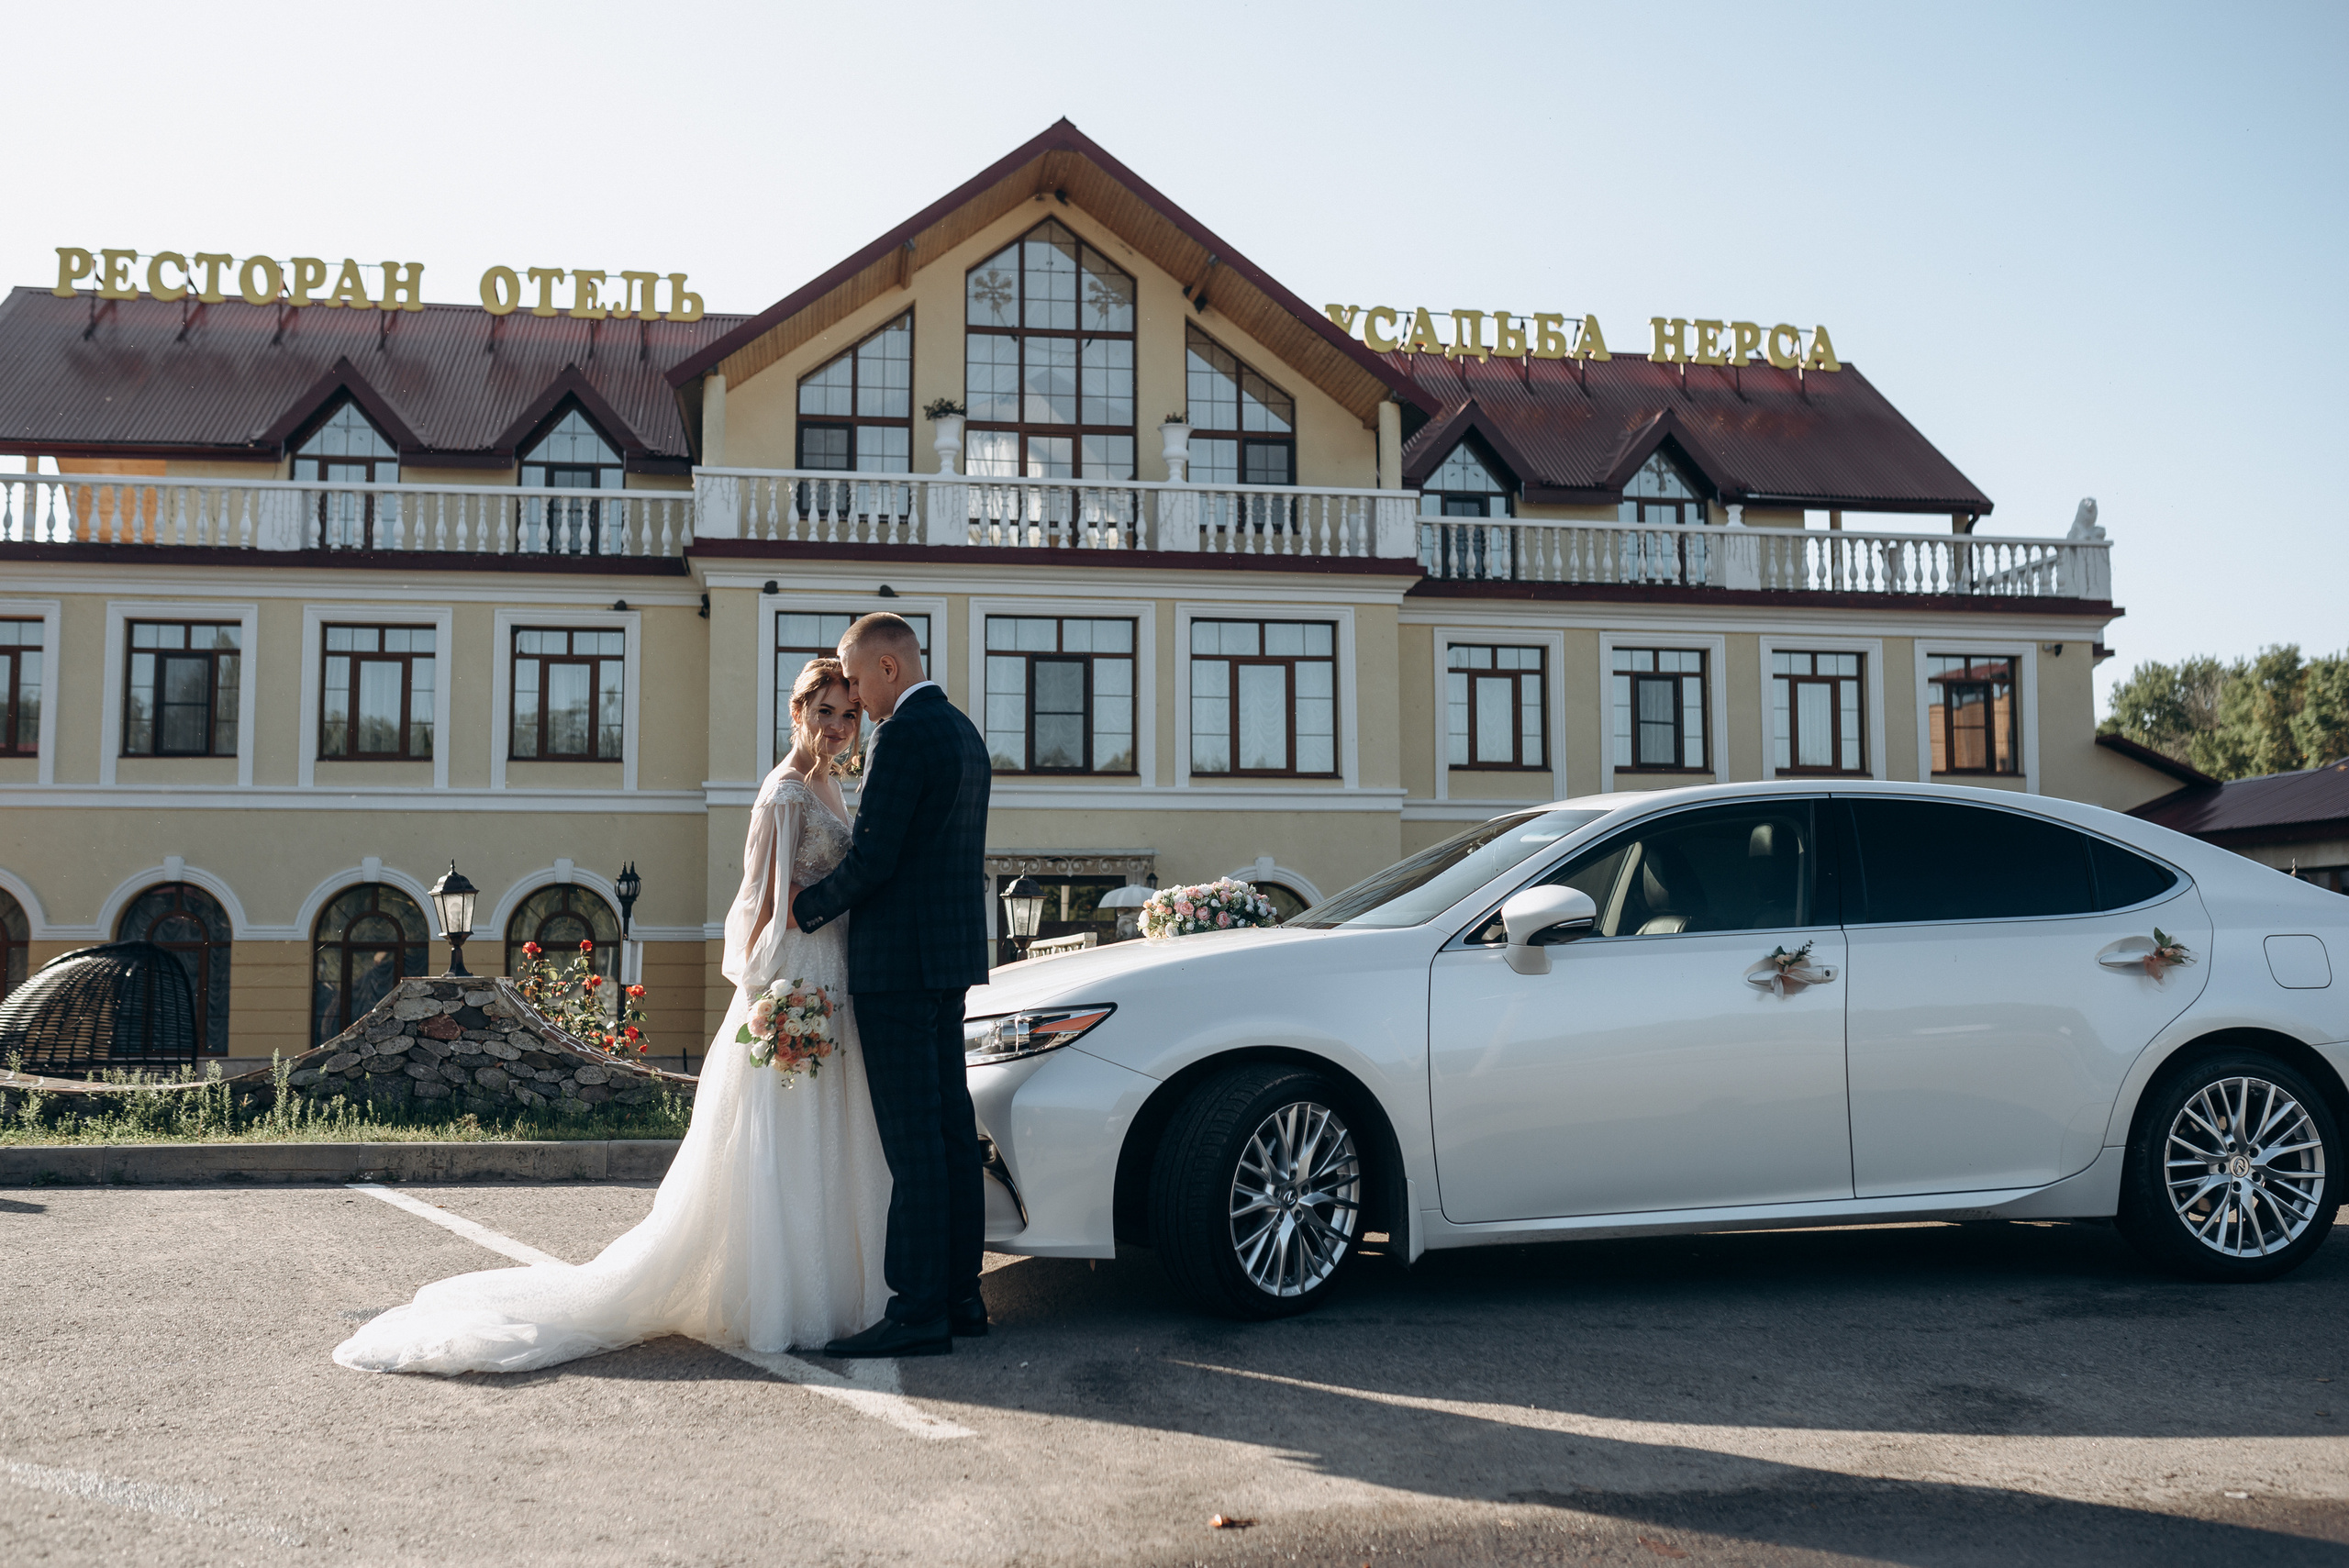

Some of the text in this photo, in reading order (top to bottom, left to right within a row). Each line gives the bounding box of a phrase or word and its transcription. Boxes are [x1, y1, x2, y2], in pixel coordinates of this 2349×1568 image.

[51, 247, 705, 322] РЕСТОРАН ОТЕЛЬ
[1323, 304, 1842, 373] УСАДЬБА НЕРСА
